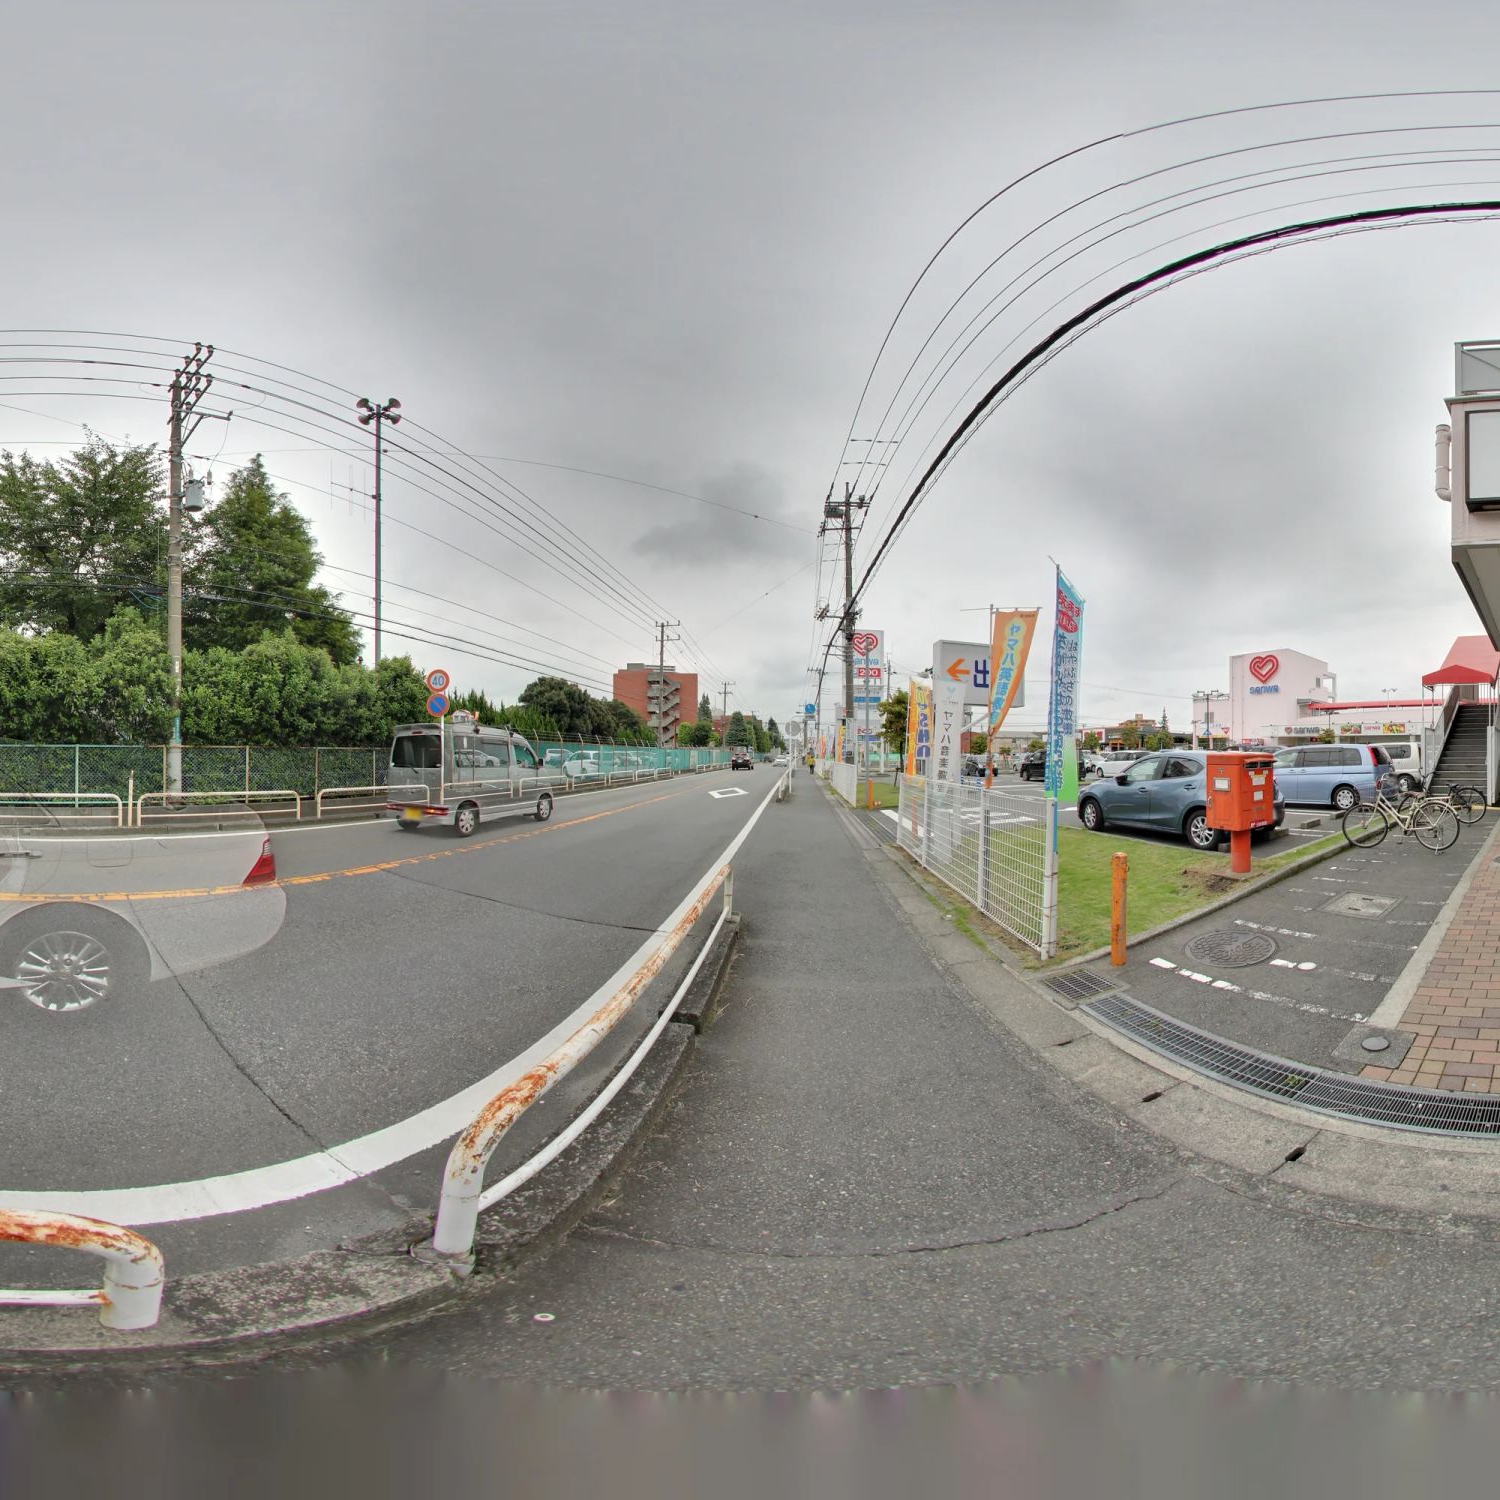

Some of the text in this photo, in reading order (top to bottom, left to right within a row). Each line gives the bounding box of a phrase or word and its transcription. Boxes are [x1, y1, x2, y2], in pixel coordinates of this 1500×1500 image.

[432, 675, 445, 686] 40
[1249, 685, 1279, 694] sanwa
[1293, 726, 1320, 734] sanwa
